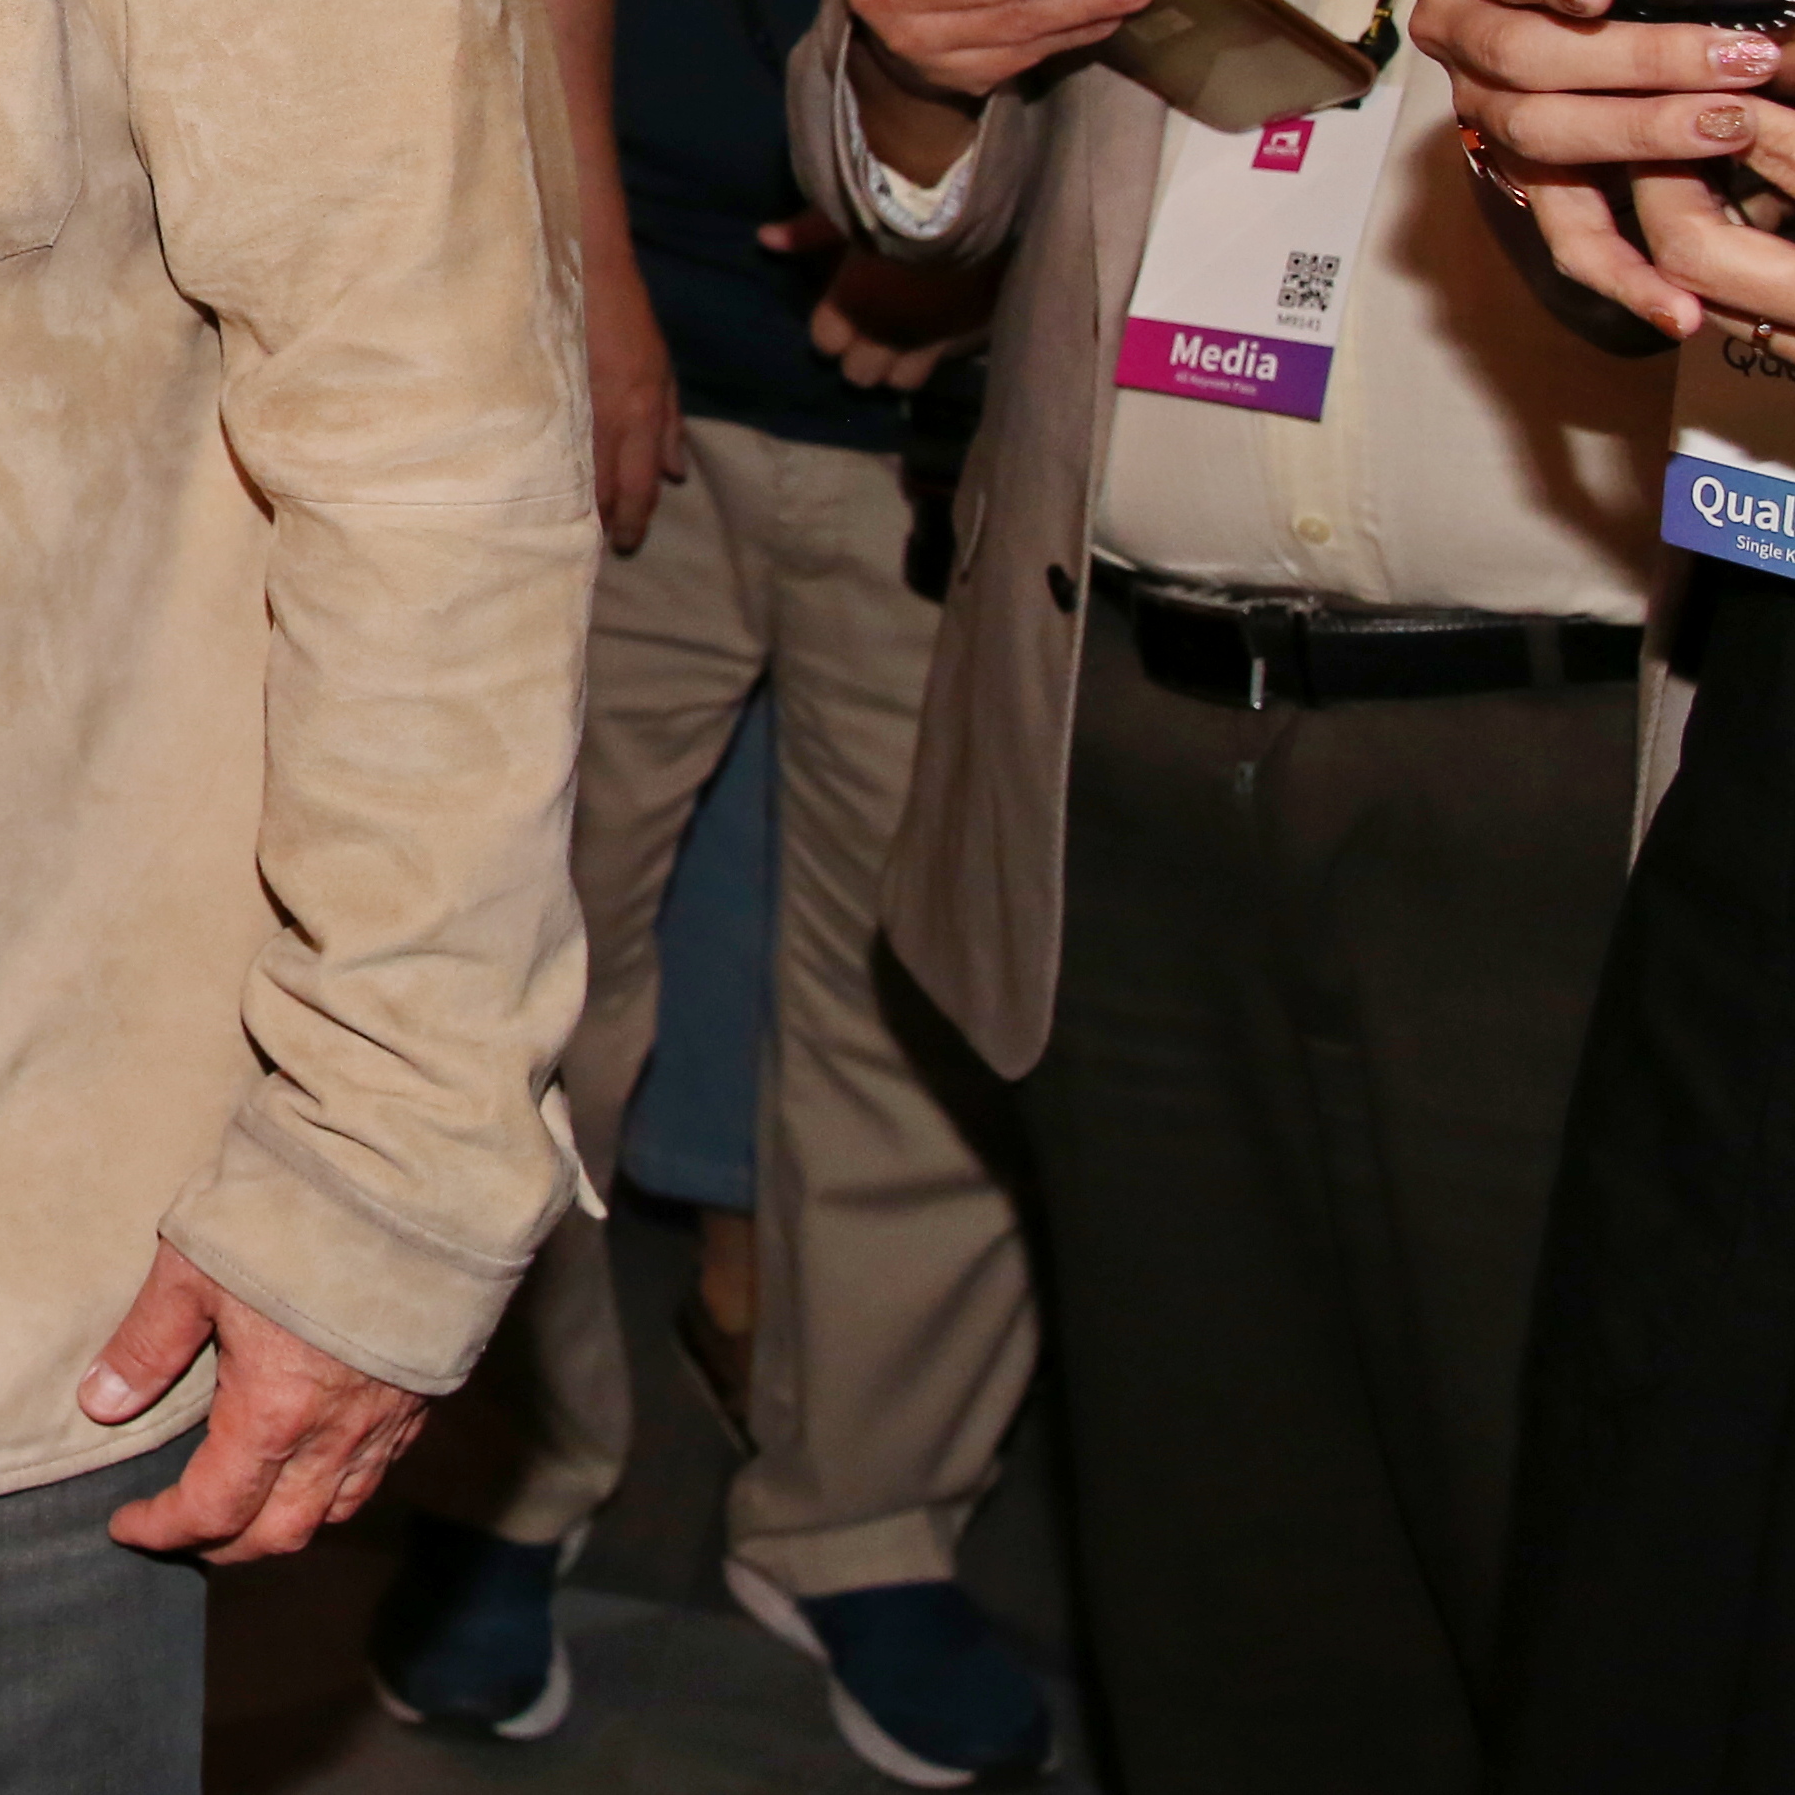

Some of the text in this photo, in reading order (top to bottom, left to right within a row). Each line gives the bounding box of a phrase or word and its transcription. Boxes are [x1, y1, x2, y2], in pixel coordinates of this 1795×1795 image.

[1169, 331, 1279, 382] Media
[1691, 475, 1795, 539] Qual
[1735, 534, 1782, 561] Single
